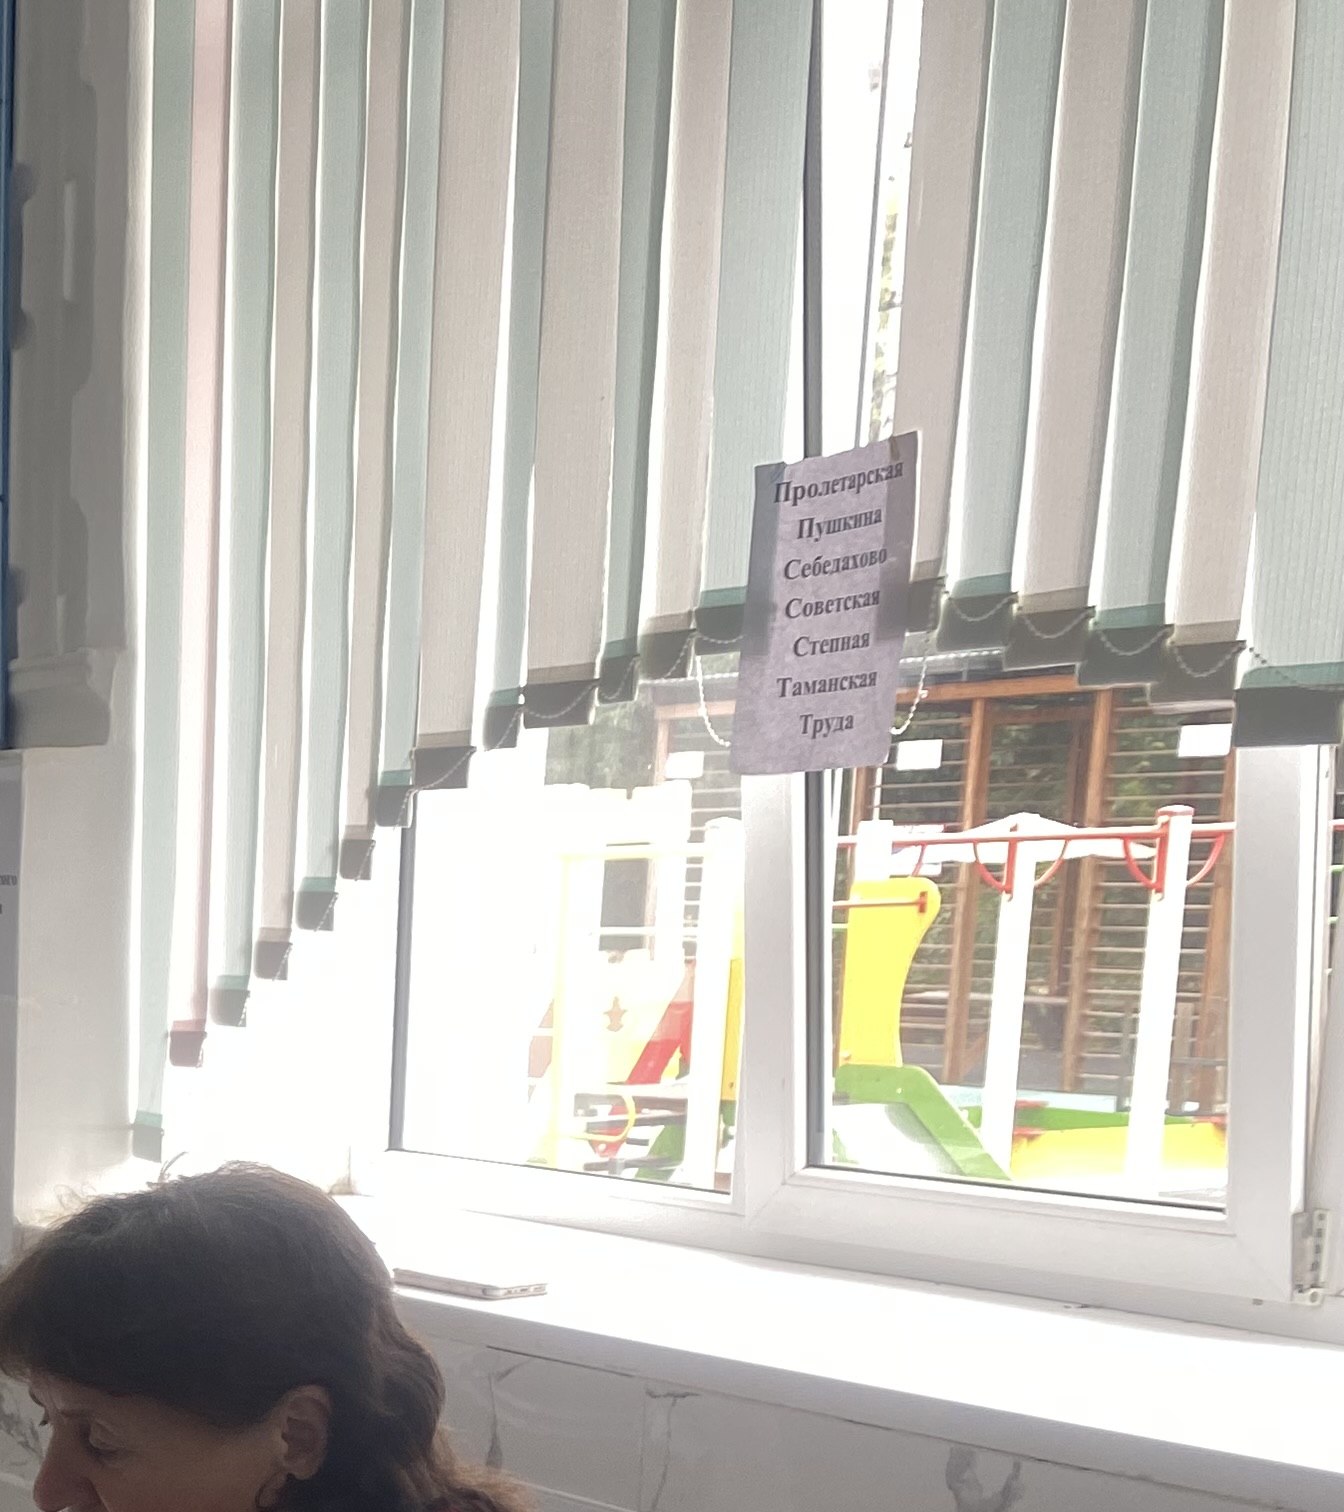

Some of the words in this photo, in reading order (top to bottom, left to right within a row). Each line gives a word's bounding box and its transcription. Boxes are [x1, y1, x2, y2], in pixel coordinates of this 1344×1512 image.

[773, 460, 904, 506] Пролетарская
[796, 507, 882, 542] Пушкина
[785, 588, 880, 619] Советская
[793, 630, 870, 657] Степная
[777, 670, 878, 698] Таманская
[800, 712, 855, 739] Труда
